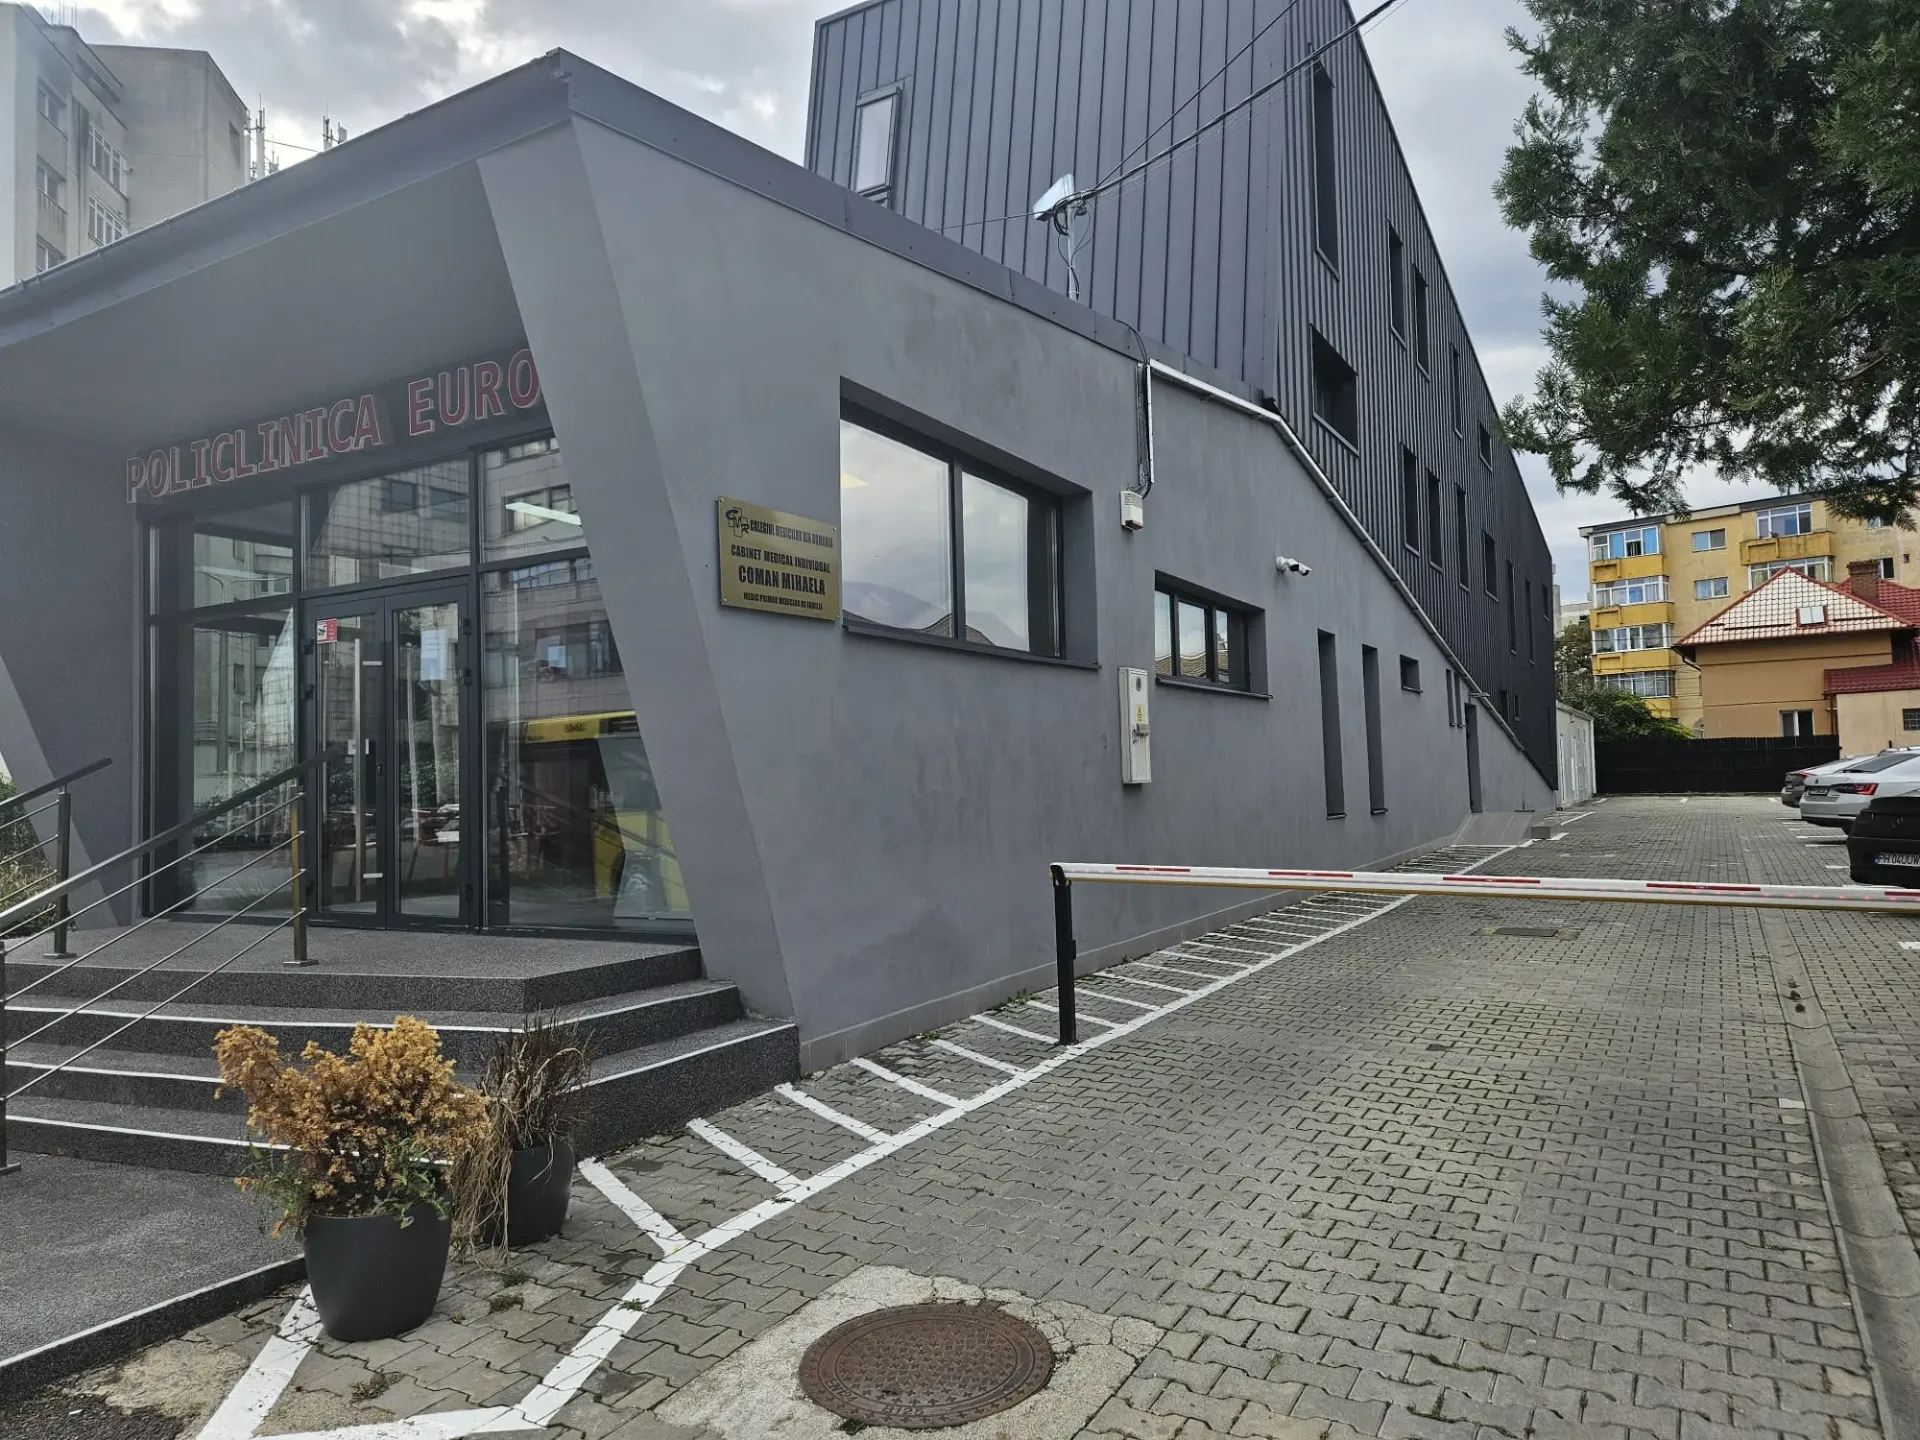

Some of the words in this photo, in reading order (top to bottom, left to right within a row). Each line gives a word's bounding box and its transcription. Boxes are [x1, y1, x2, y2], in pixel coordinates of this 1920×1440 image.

[126, 394, 383, 503] POLICLINICA
[731, 544, 762, 560] CABINET
[764, 551, 793, 566] MEDICAL
[795, 557, 831, 573] INDIVIDUAL
[738, 565, 780, 588] COMAN
[781, 572, 826, 595] MIHAELA
